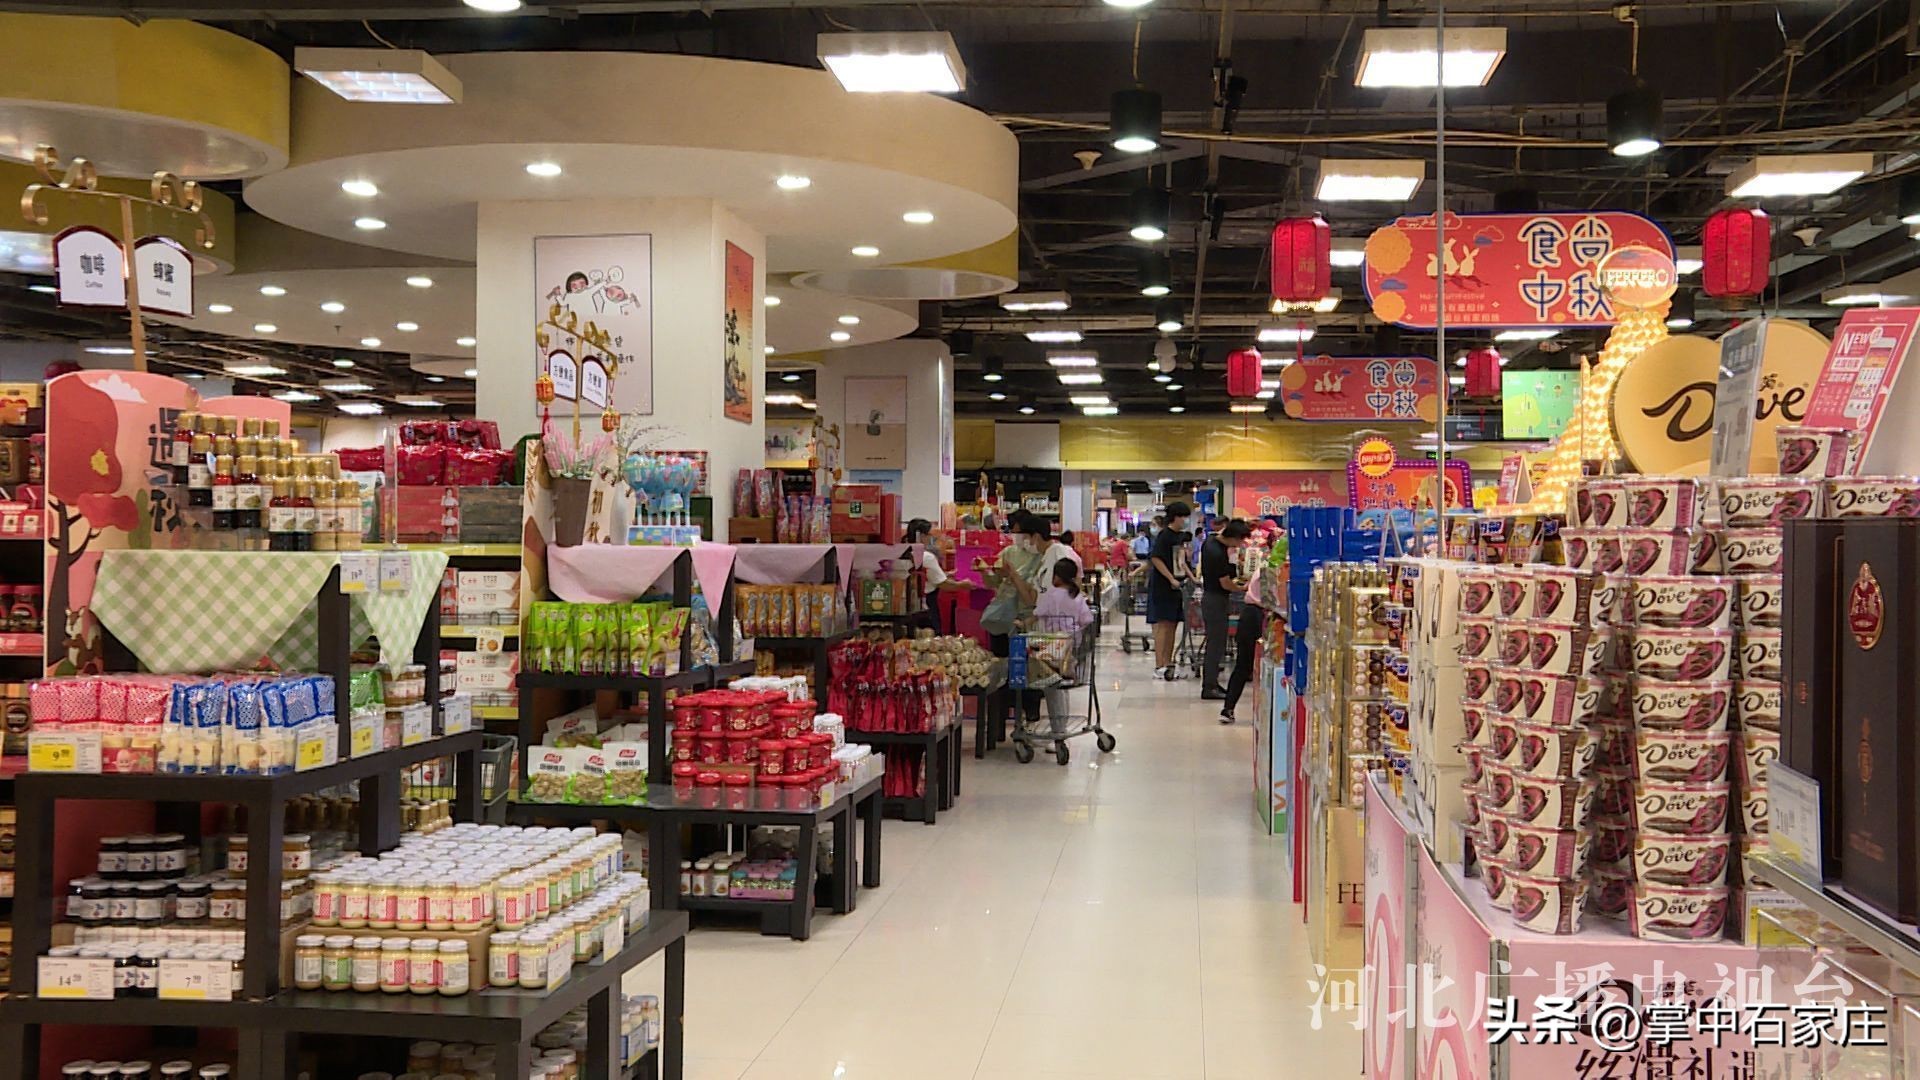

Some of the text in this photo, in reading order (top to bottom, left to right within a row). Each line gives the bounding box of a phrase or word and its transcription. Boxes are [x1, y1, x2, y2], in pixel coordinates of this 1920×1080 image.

[1519, 218, 1612, 267] 食尚
[79, 252, 105, 275] 咖啡
[1605, 267, 1669, 288] FERRERO
[1521, 271, 1614, 321] 中秋
[1837, 332, 1871, 355] NEW
[1366, 360, 1416, 387] 食尚
[1366, 390, 1418, 417] 中秋
[1641, 382, 1807, 442] Dve
[1721, 494, 1775, 515] Dove
[1832, 489, 1891, 510] Dove
[1722, 541, 1780, 562] Dove
[1634, 588, 1690, 608] Dove
[1743, 591, 1779, 611] Do
[1633, 640, 1687, 660] Dove
[1742, 643, 1778, 664] Do
[1633, 693, 1690, 714] Dove
[1639, 743, 1699, 764] Dove
[1638, 795, 1697, 814] Dove
[1637, 847, 1699, 867] Dove
[1638, 896, 1701, 917] Dove
